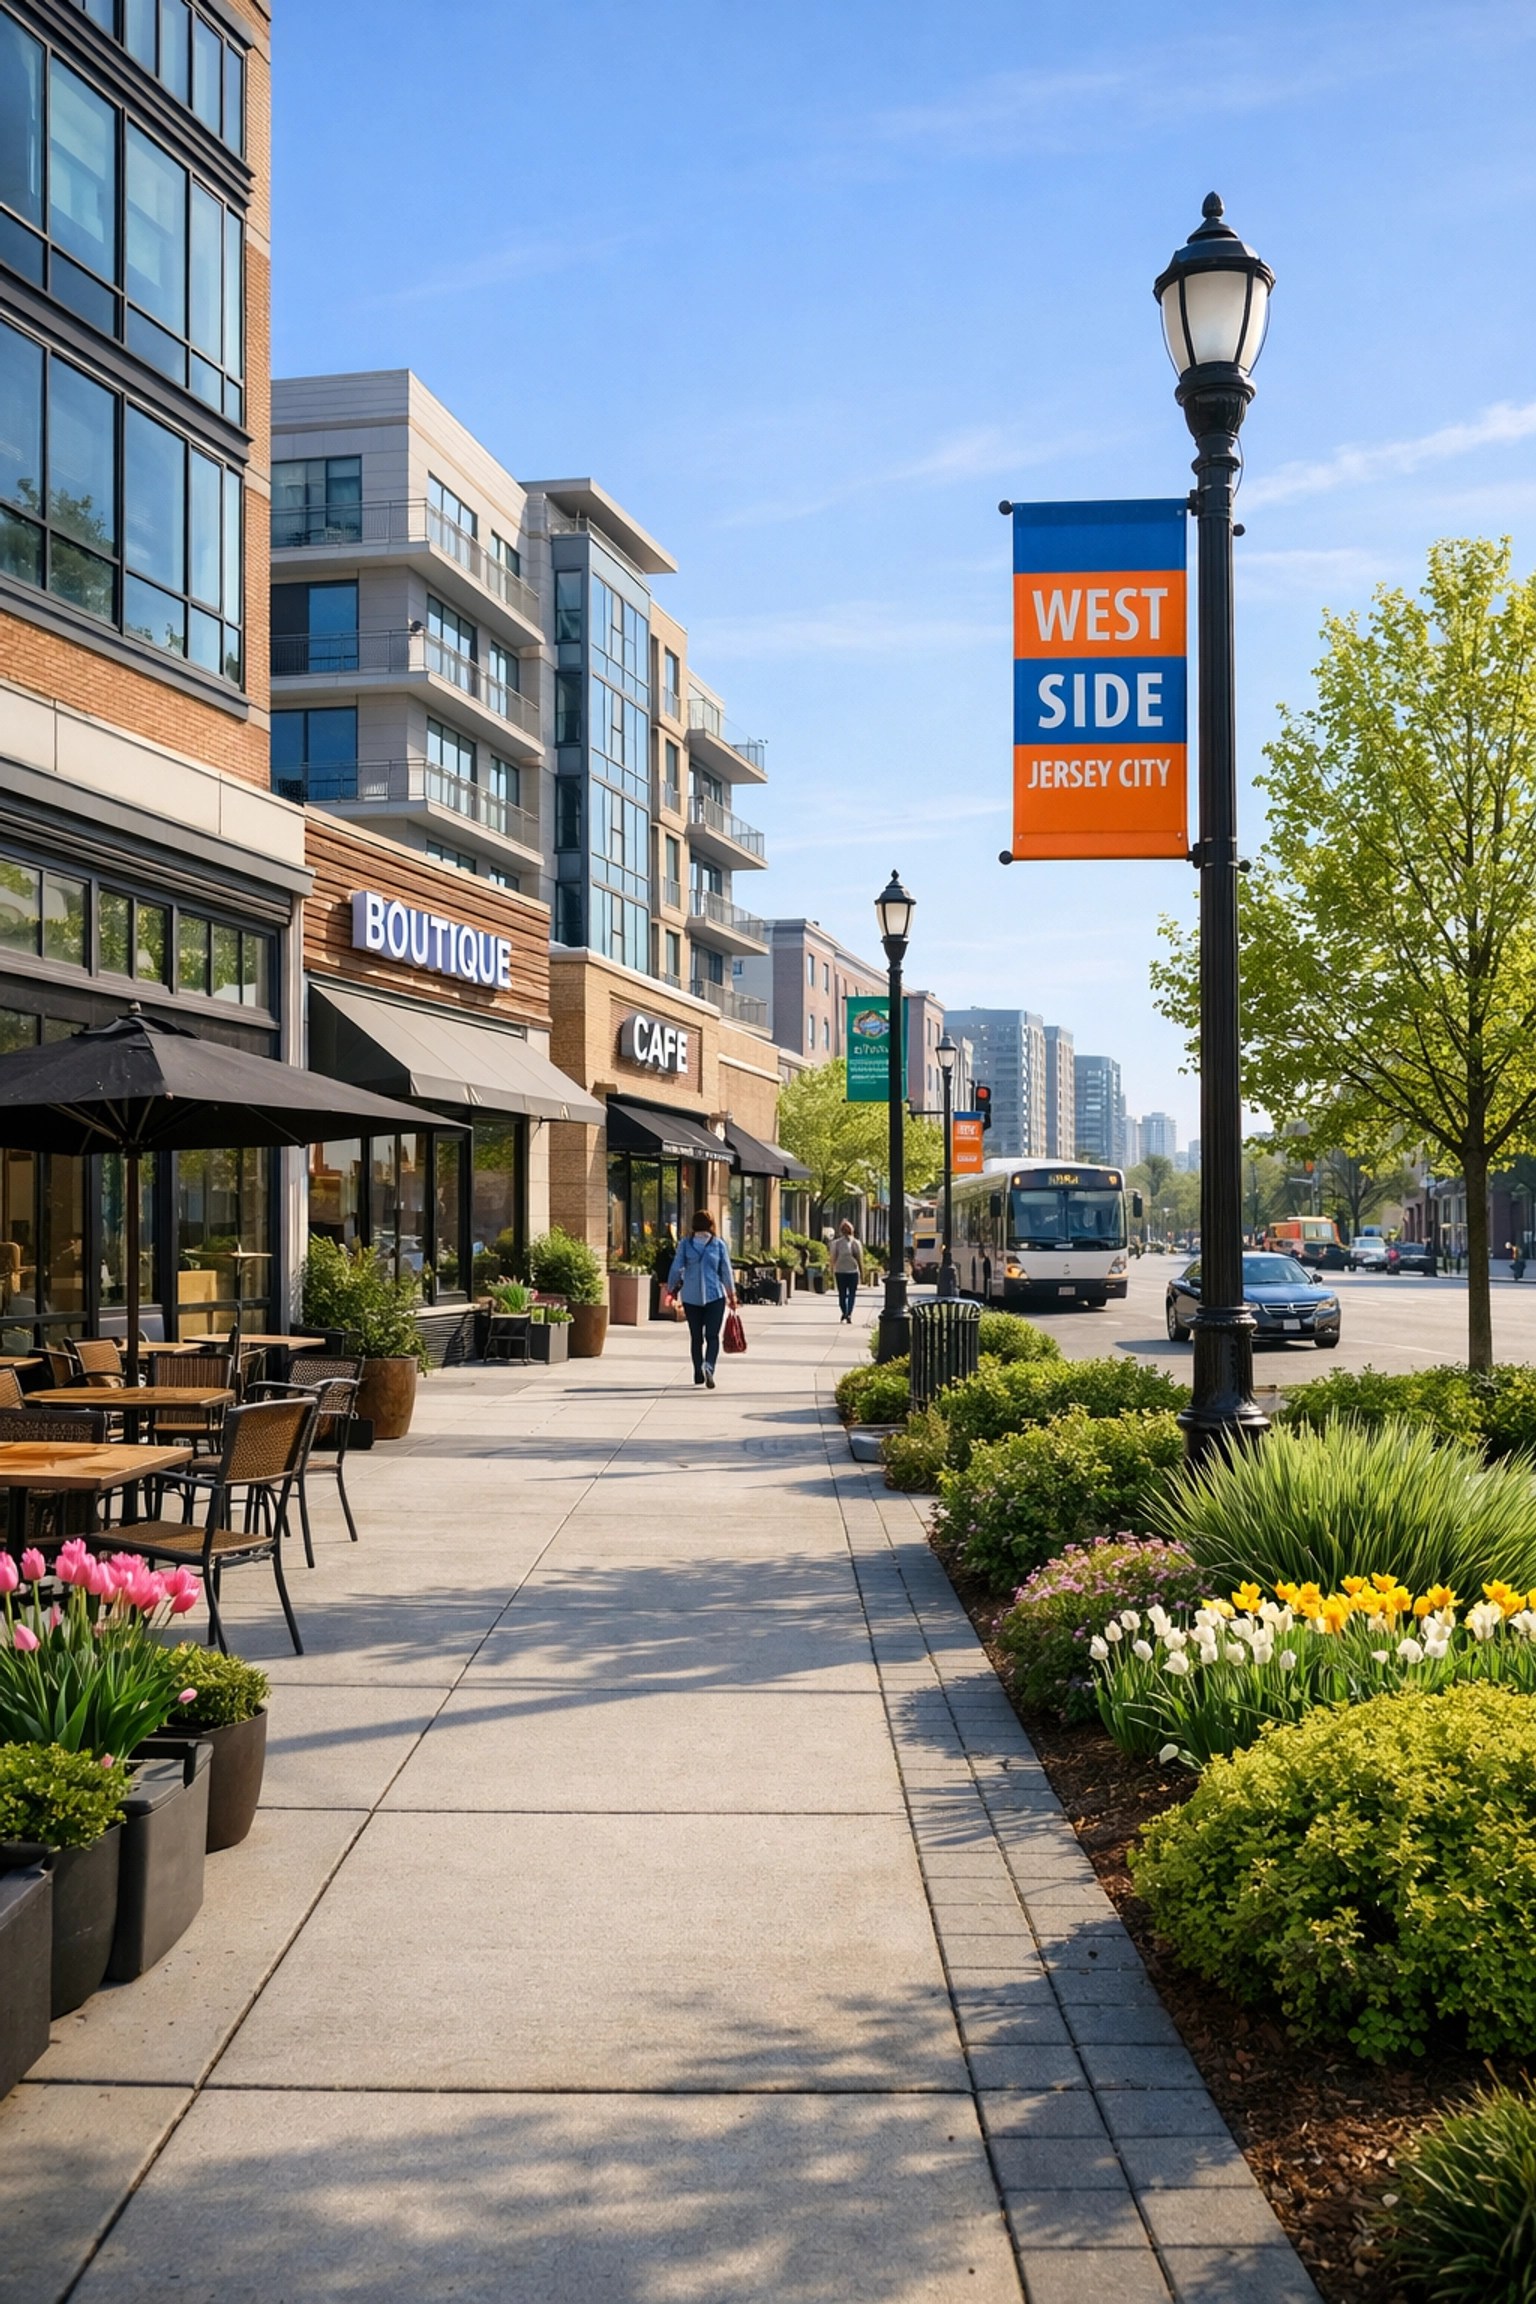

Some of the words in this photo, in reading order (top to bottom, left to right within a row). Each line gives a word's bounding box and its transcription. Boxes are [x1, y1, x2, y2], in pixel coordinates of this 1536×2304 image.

[1032, 588, 1168, 642] WEST
[1038, 672, 1163, 728] SIDE
[1027, 759, 1112, 788] JERSEY
[1118, 758, 1171, 788] CITY
[366, 891, 512, 988] BOUTIQUE
[633, 1015, 688, 1074] CAFE
